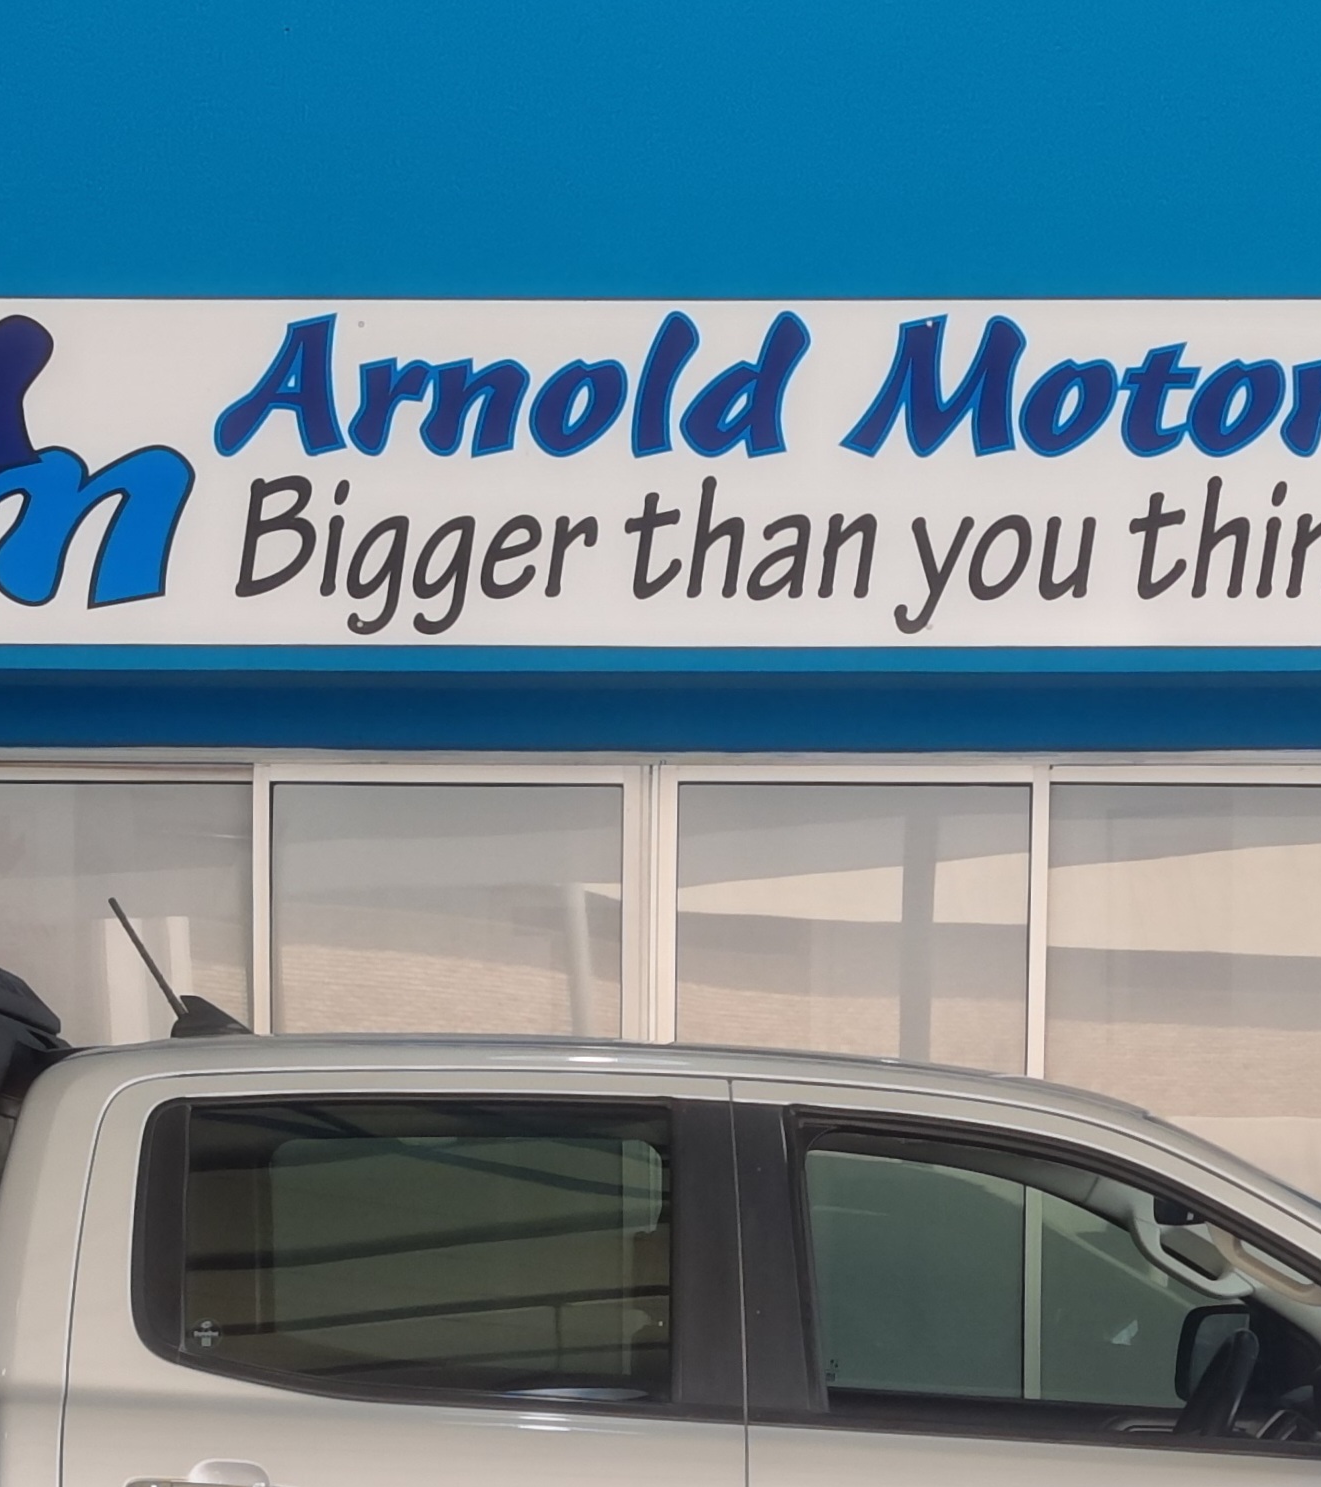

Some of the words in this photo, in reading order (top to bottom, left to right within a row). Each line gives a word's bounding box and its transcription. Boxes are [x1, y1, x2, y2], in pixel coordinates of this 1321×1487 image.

[214, 310, 811, 458] Arnold
[235, 475, 598, 634] Bigger
[625, 475, 878, 600] than
[894, 513, 1096, 634] you
